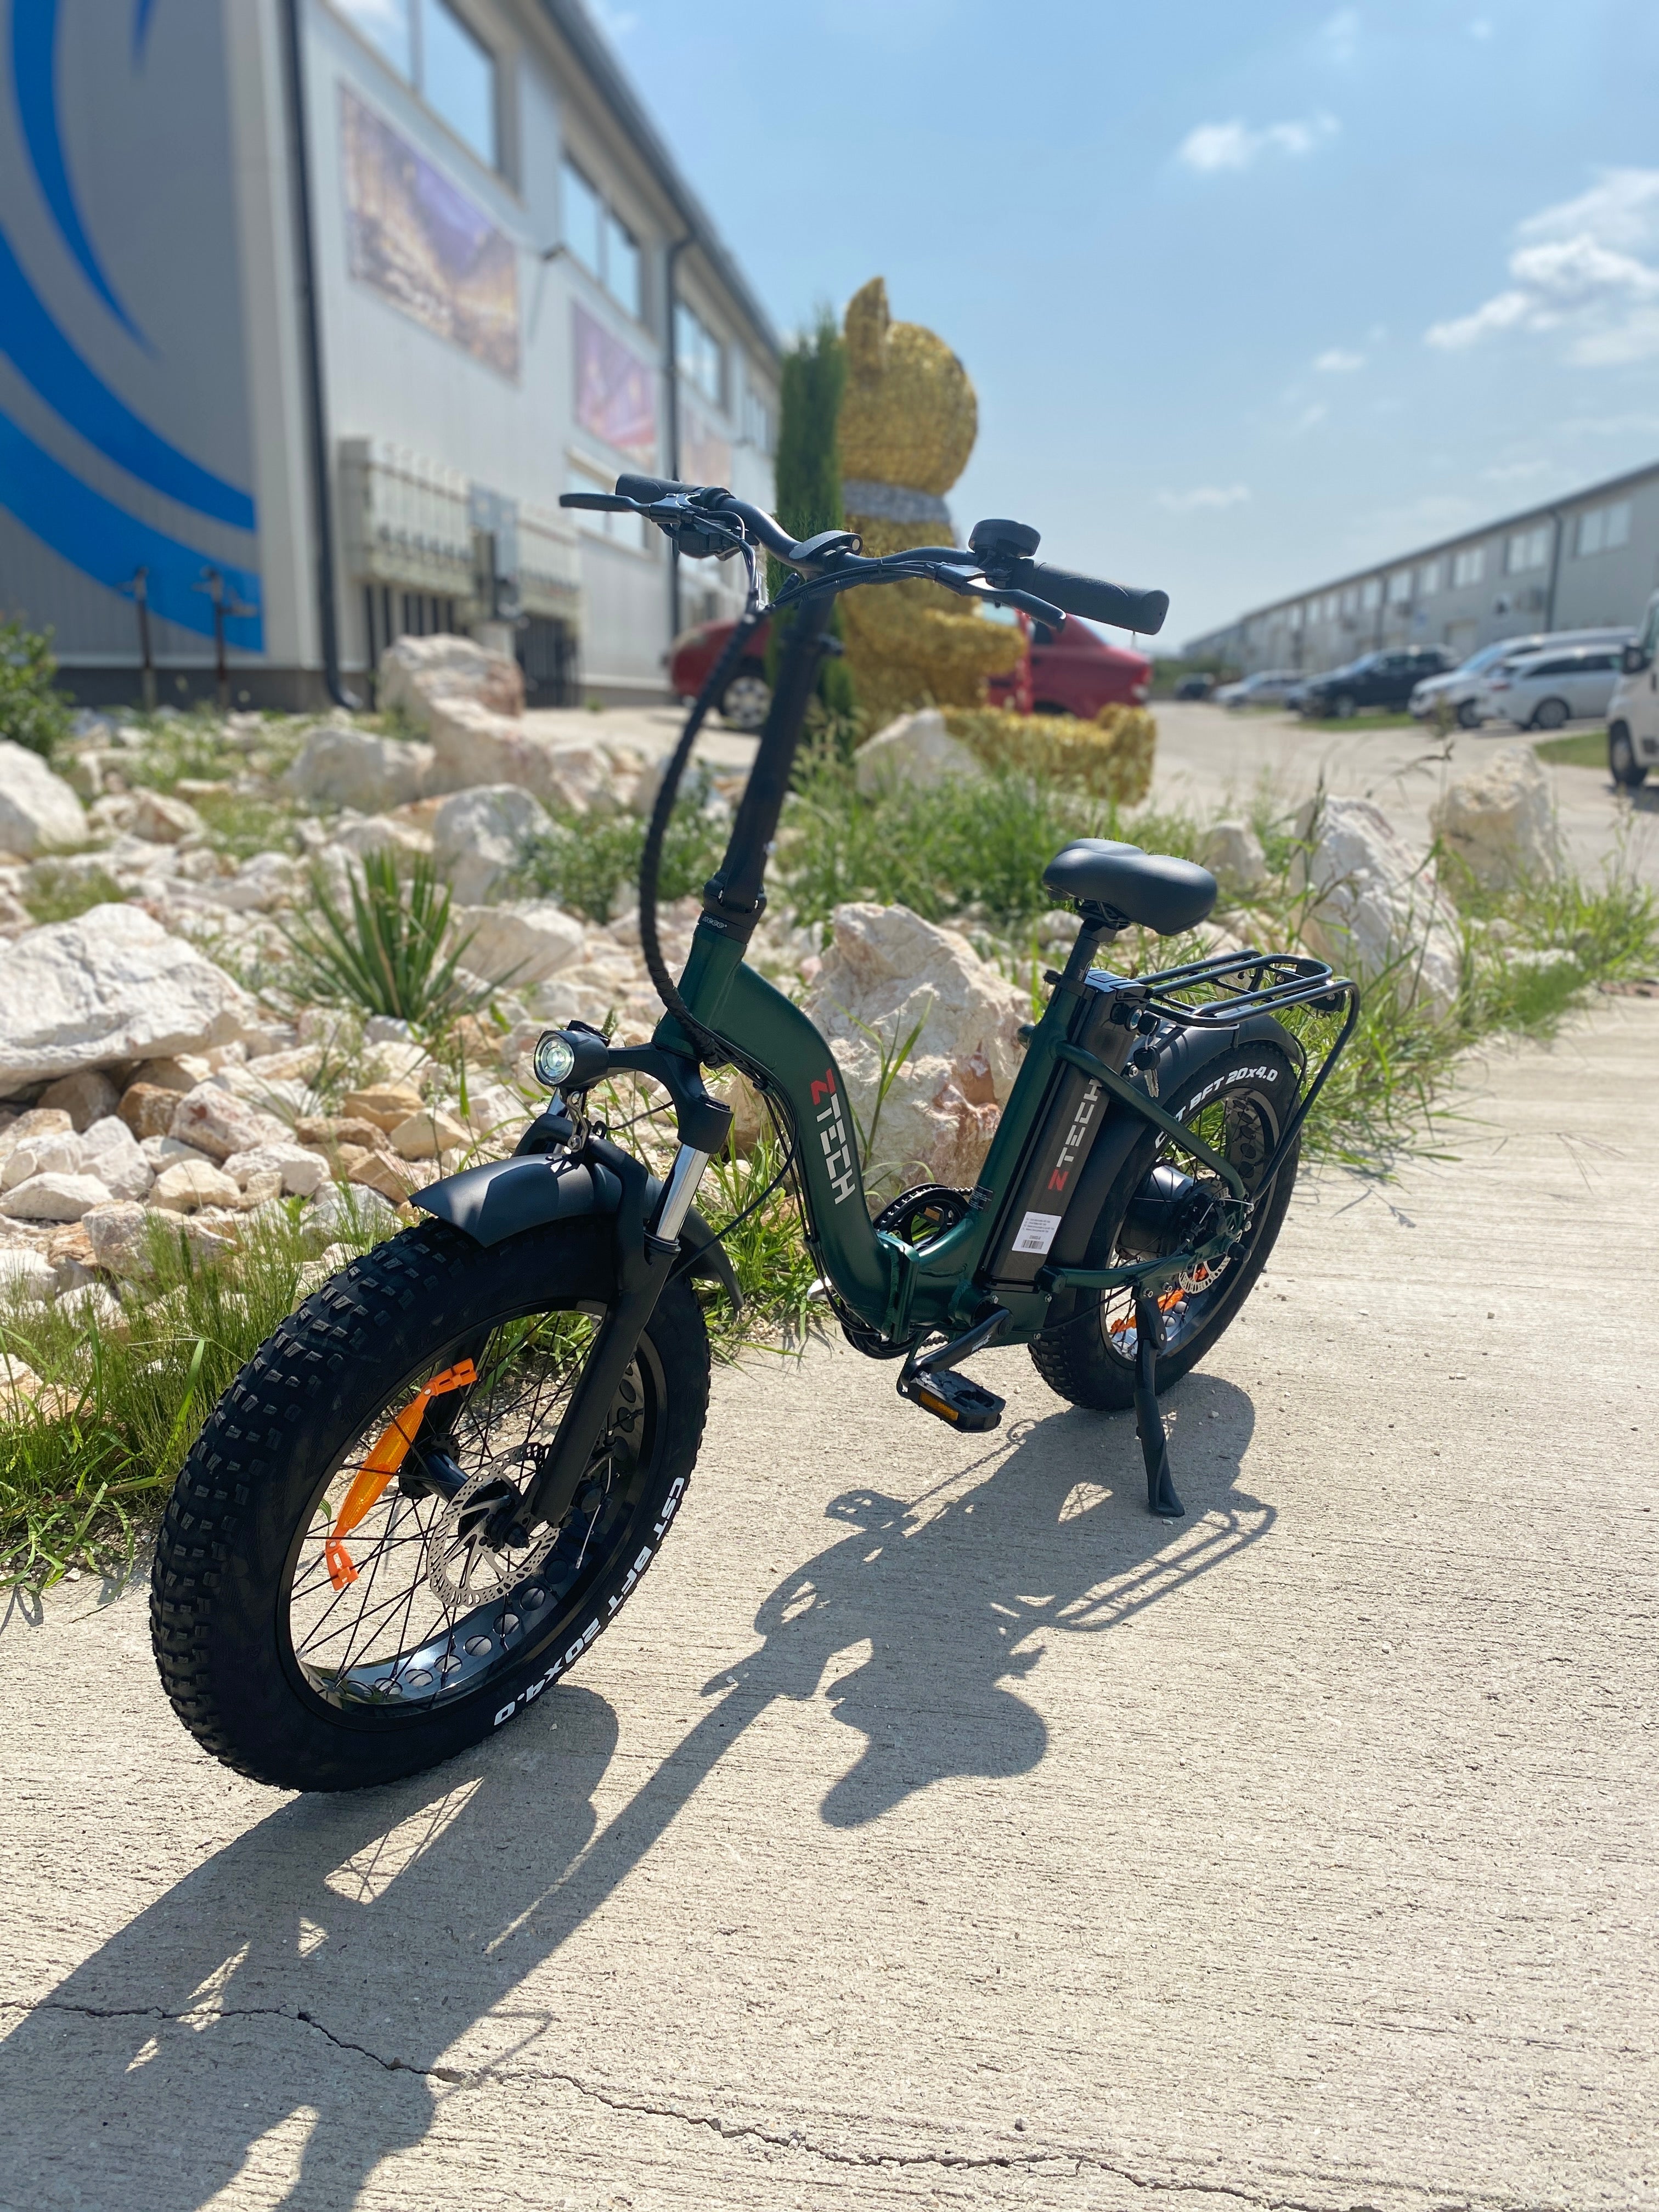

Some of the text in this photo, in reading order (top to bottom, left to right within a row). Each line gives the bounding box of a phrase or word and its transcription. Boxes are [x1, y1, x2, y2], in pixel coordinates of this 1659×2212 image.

[1155, 1105, 1186, 1149] CT
[1189, 1076, 1225, 1111] BFT
[653, 1477, 685, 1541] CST
[607, 1545, 652, 1616] BFT
